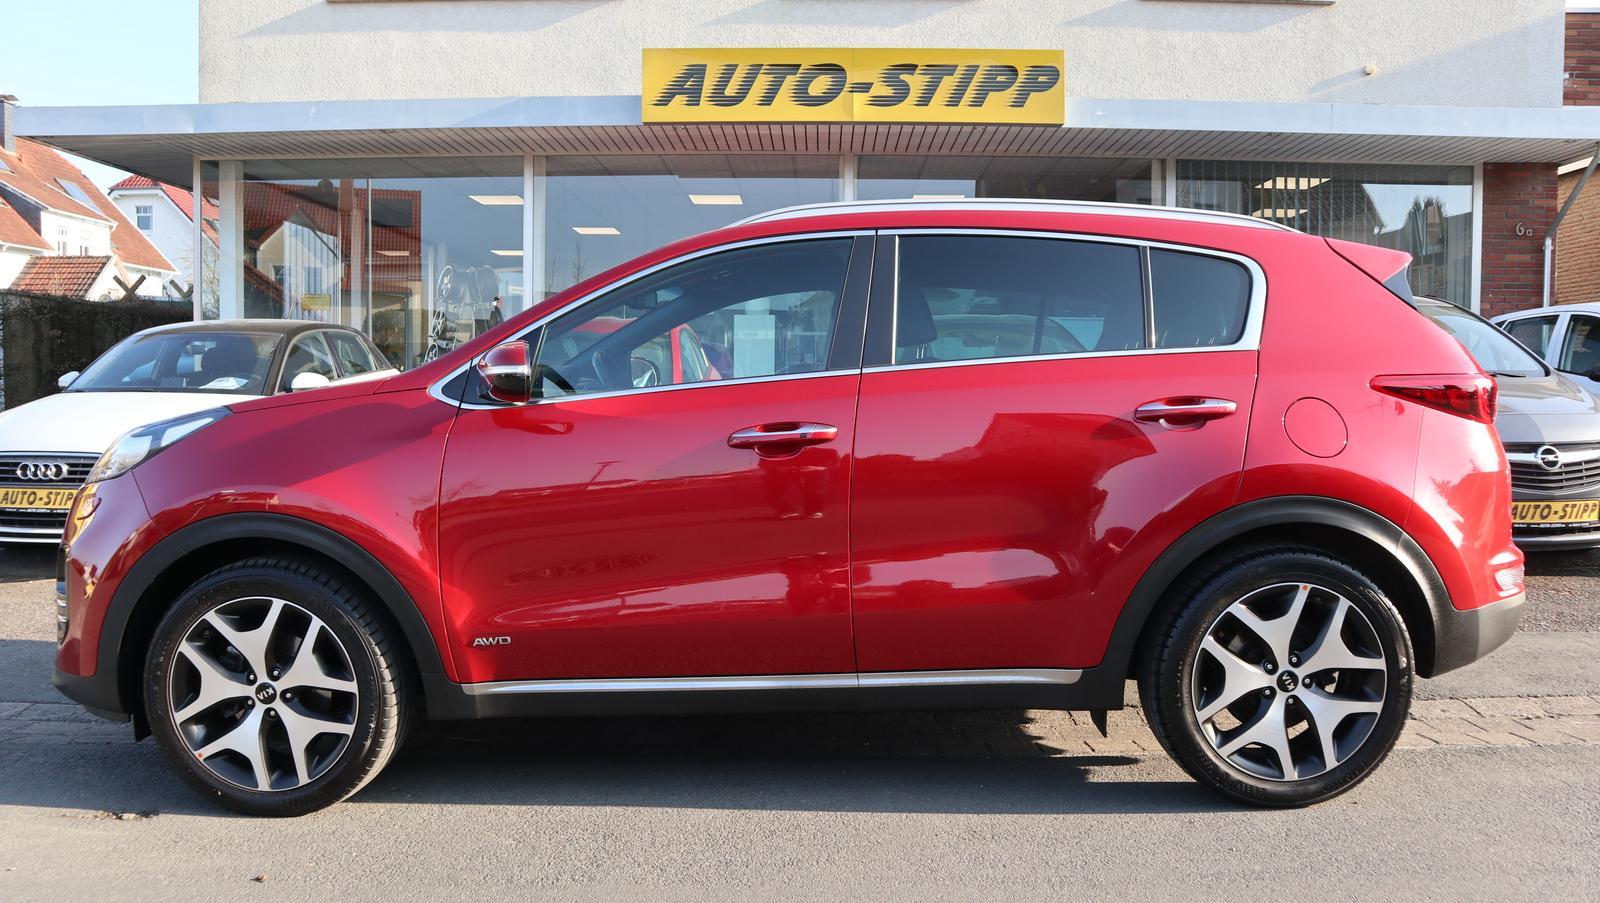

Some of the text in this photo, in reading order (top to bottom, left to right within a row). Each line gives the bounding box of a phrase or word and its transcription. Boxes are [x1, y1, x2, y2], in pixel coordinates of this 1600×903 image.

[648, 63, 1060, 108] AUTO-STIPP
[0, 490, 76, 506] AUTO-STIP
[472, 636, 511, 646] AWD
[257, 687, 274, 700] KIA
